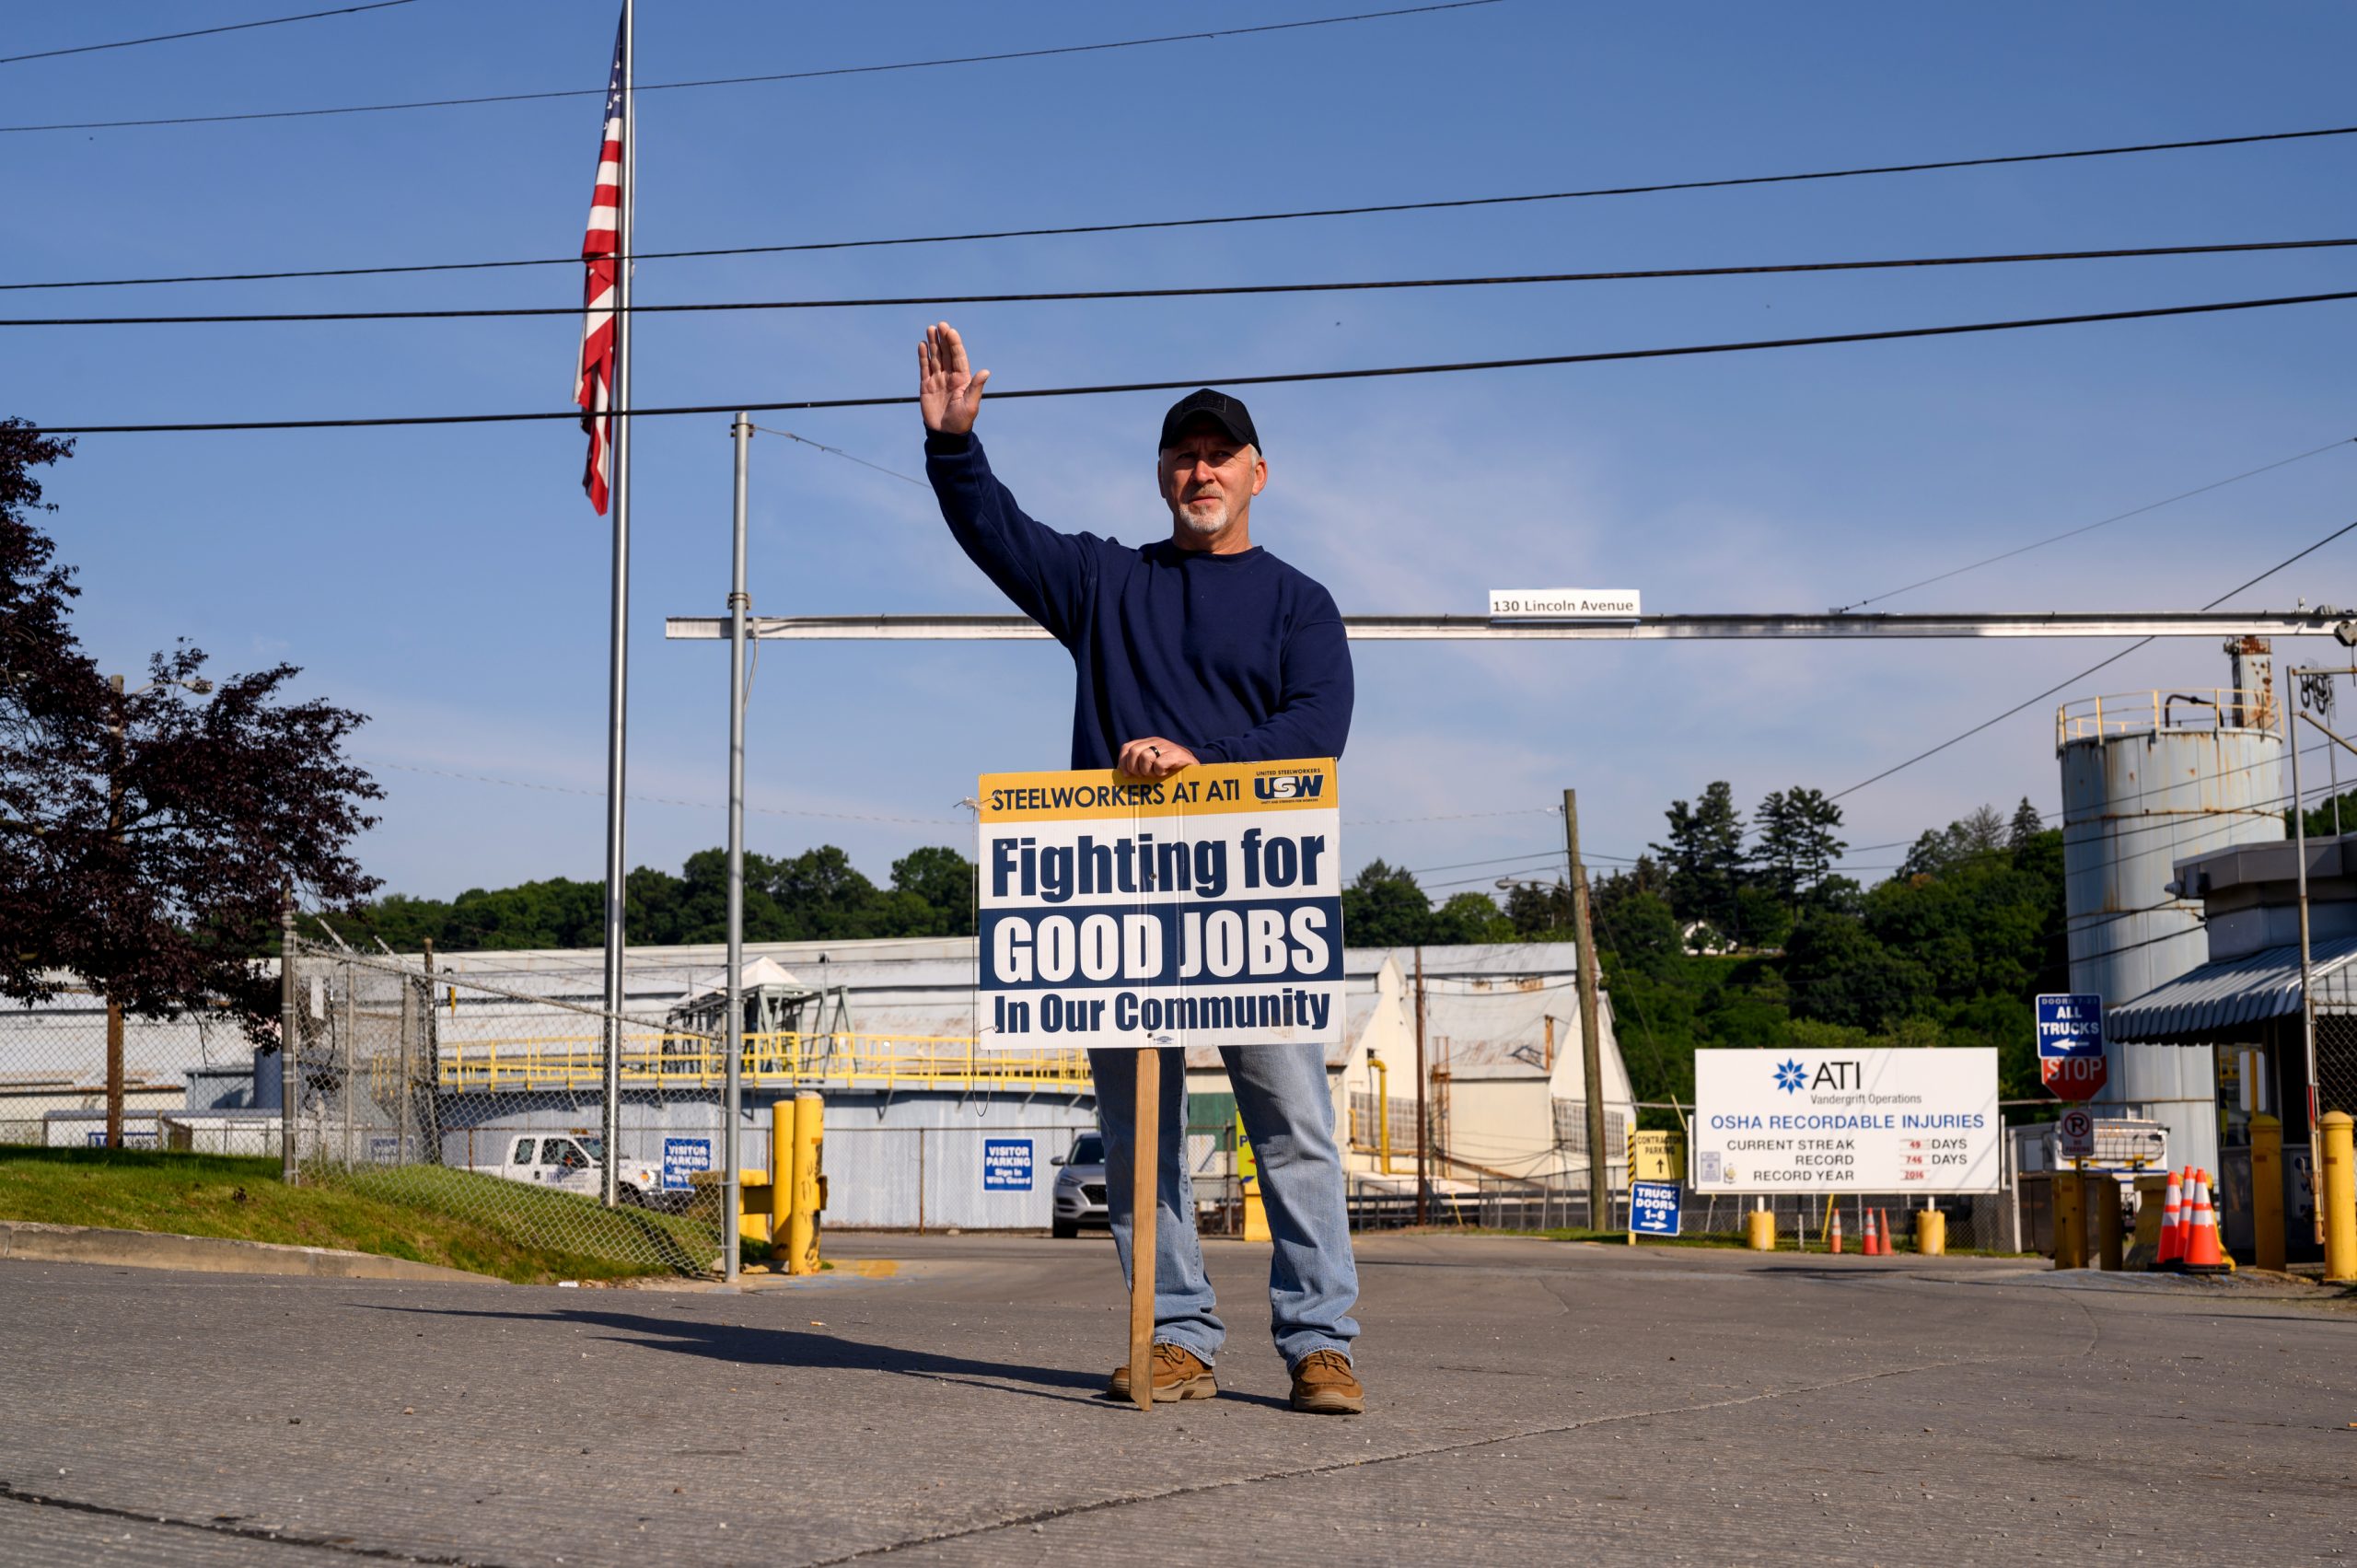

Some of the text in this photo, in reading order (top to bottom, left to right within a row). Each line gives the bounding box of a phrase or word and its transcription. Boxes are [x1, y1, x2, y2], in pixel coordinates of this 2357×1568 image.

[1493, 599, 1633, 612] 130 Lincoln Avenue
[1254, 774, 1324, 800] USW
[991, 779, 1240, 811] STEELWORKERS AT ATI
[992, 828, 1326, 903] Fighting for
[993, 906, 1329, 983] GOOD JOBS
[993, 988, 1331, 1034] In Our Community
[2056, 1005, 2083, 1019] ALL
[2040, 1021, 2100, 1036] TRUCKS
[1812, 1062, 1861, 1090] ATI
[2047, 1058, 2102, 1082] STOP
[1810, 1093, 1922, 1106] Vandergrift Operations
[1711, 1113, 1985, 1130] OSHA RECORDABLE INJURIES
[1637, 1135, 1682, 1144] CONTRACTOR
[1727, 1139, 1794, 1151] CURRENT
[1797, 1139, 1855, 1150] STREAK
[1931, 1138, 1968, 1150] DAYS
[668, 1145, 707, 1156] VISITOR
[988, 1146, 1029, 1156] VISITOR
[1644, 1146, 1676, 1156] PARKING
[666, 1156, 709, 1167] PARKING
[986, 1156, 1031, 1167] PARKING
[1795, 1154, 1854, 1166] RECORD
[1931, 1154, 1968, 1165] DAYS
[1753, 1170, 1812, 1181] RECORD
[1817, 1170, 1854, 1181] YEAR
[1637, 1187, 1676, 1200] TRUCK
[1635, 1198, 1677, 1211] DOORS
[1643, 1209, 1666, 1221] 1-6
